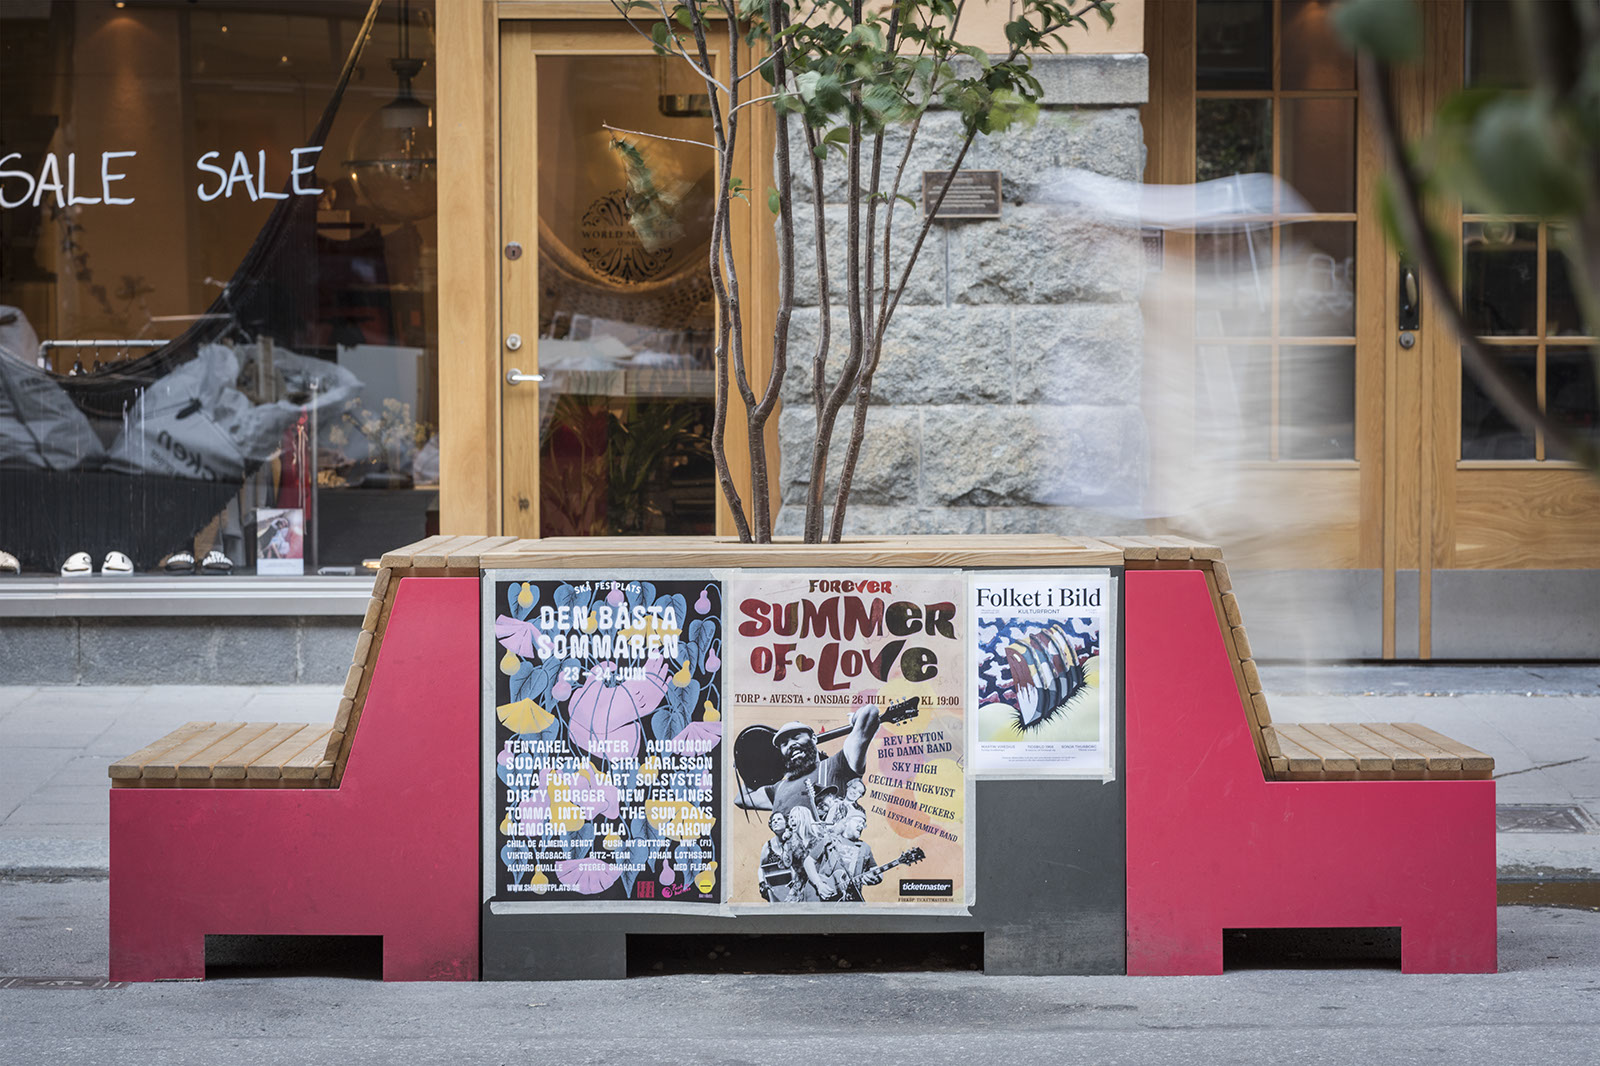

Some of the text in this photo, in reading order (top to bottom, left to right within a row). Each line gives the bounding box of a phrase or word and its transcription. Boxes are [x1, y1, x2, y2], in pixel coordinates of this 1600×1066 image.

[0, 151, 137, 208] SALE
[197, 146, 324, 202] SALE
[582, 230, 623, 239] WORLD
[574, 581, 641, 594] SKÅ FESTPLATS
[976, 588, 1101, 607] Folket i Bild
[540, 602, 678, 630] DEN BÄSTA
[537, 634, 680, 660] SOMMAREN
[750, 642, 798, 682] OF
[563, 667, 580, 681] 23
[594, 667, 612, 681] 24
[616, 667, 647, 681] JUNI
[735, 693, 960, 706] TORP AVESTA ONSDAG 26 JULI KL 19:00
[883, 731, 944, 746] REV PEYTON
[504, 739, 712, 753] TENTAKEL HATER AUDIONOM
[878, 742, 952, 759] BIG DAMN BAND
[506, 756, 713, 770] SUDAKISTAN SIRI KARLSSON
[892, 761, 938, 775] SKY HIGH
[506, 773, 540, 786] DATA
[546, 773, 580, 786] FURY
[636, 773, 713, 787] SOLSYSTEM
[868, 774, 956, 798] CECILIA RINGKVIST
[506, 789, 713, 803] DIRTY BURGER NEW FEELINGS
[870, 790, 956, 820] MUSHROOM PICKERS
[505, 806, 713, 820] TOMMA INTET THE SUN DAYS
[507, 822, 711, 836] MEMORIA LULA KRAKOW
[871, 805, 958, 843] LISA LYSTAM FAMILY BAND
[602, 839, 623, 847] PUSH
[625, 839, 637, 847] MY
[638, 839, 671, 847] BUTTONS
[507, 851, 533, 860] VIKTOR
[648, 851, 672, 860] JOHAN
[578, 863, 606, 872] STEREO
[673, 863, 689, 872] MED
[690, 863, 712, 872] FLERA
[902, 883, 949, 891] ticketmaster
